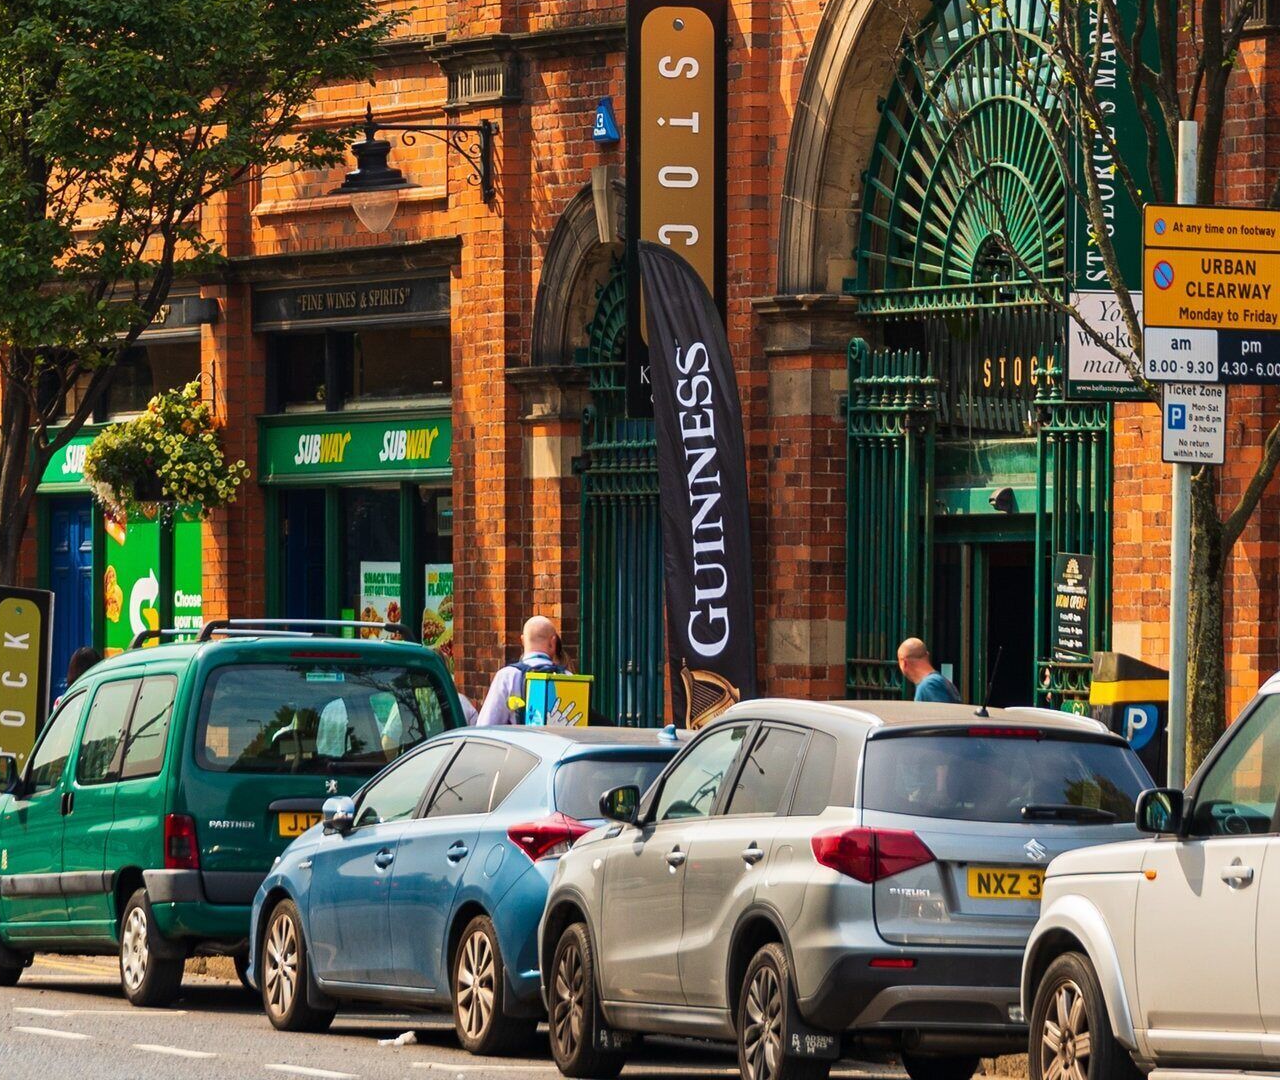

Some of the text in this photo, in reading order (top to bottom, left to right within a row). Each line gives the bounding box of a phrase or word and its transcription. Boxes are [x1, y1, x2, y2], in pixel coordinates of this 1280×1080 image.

[657, 55, 700, 246] STOC
[1172, 222, 1276, 239] At any time on footway
[1201, 258, 1257, 276] URBAN
[1185, 281, 1272, 300] CLEARWAY
[326, 291, 357, 310] WINES
[359, 291, 368, 309] &
[1098, 300, 1144, 322] Yor
[1178, 306, 1279, 325] Monday to Friday
[1077, 325, 1135, 348] week
[1170, 338, 1192, 351] am
[1241, 340, 1263, 356] pm
[983, 355, 1056, 388] STOCK
[1149, 359, 1178, 373] 8.00
[1186, 360, 1215, 375] 9.30
[1221, 361, 1248, 376] 4.30
[1168, 383, 1223, 398] Ticket Zone
[1192, 424, 1217, 434] 2 hours
[1211, 415, 1222, 425] pm
[294, 430, 352, 467] SUBWAY
[379, 425, 440, 463] SUBWAY
[1178, 438, 1210, 447] No return
[61, 443, 87, 474] SUB
[1173, 449, 1193, 458] within
[1199, 451, 1214, 459] hour
[676, 340, 730, 658] GUINNESS
[174, 589, 202, 608] Choose
[208, 819, 256, 829] PARTNER
[888, 886, 931, 898] SUZUKI
[977, 872, 1045, 897] NXZ 3
